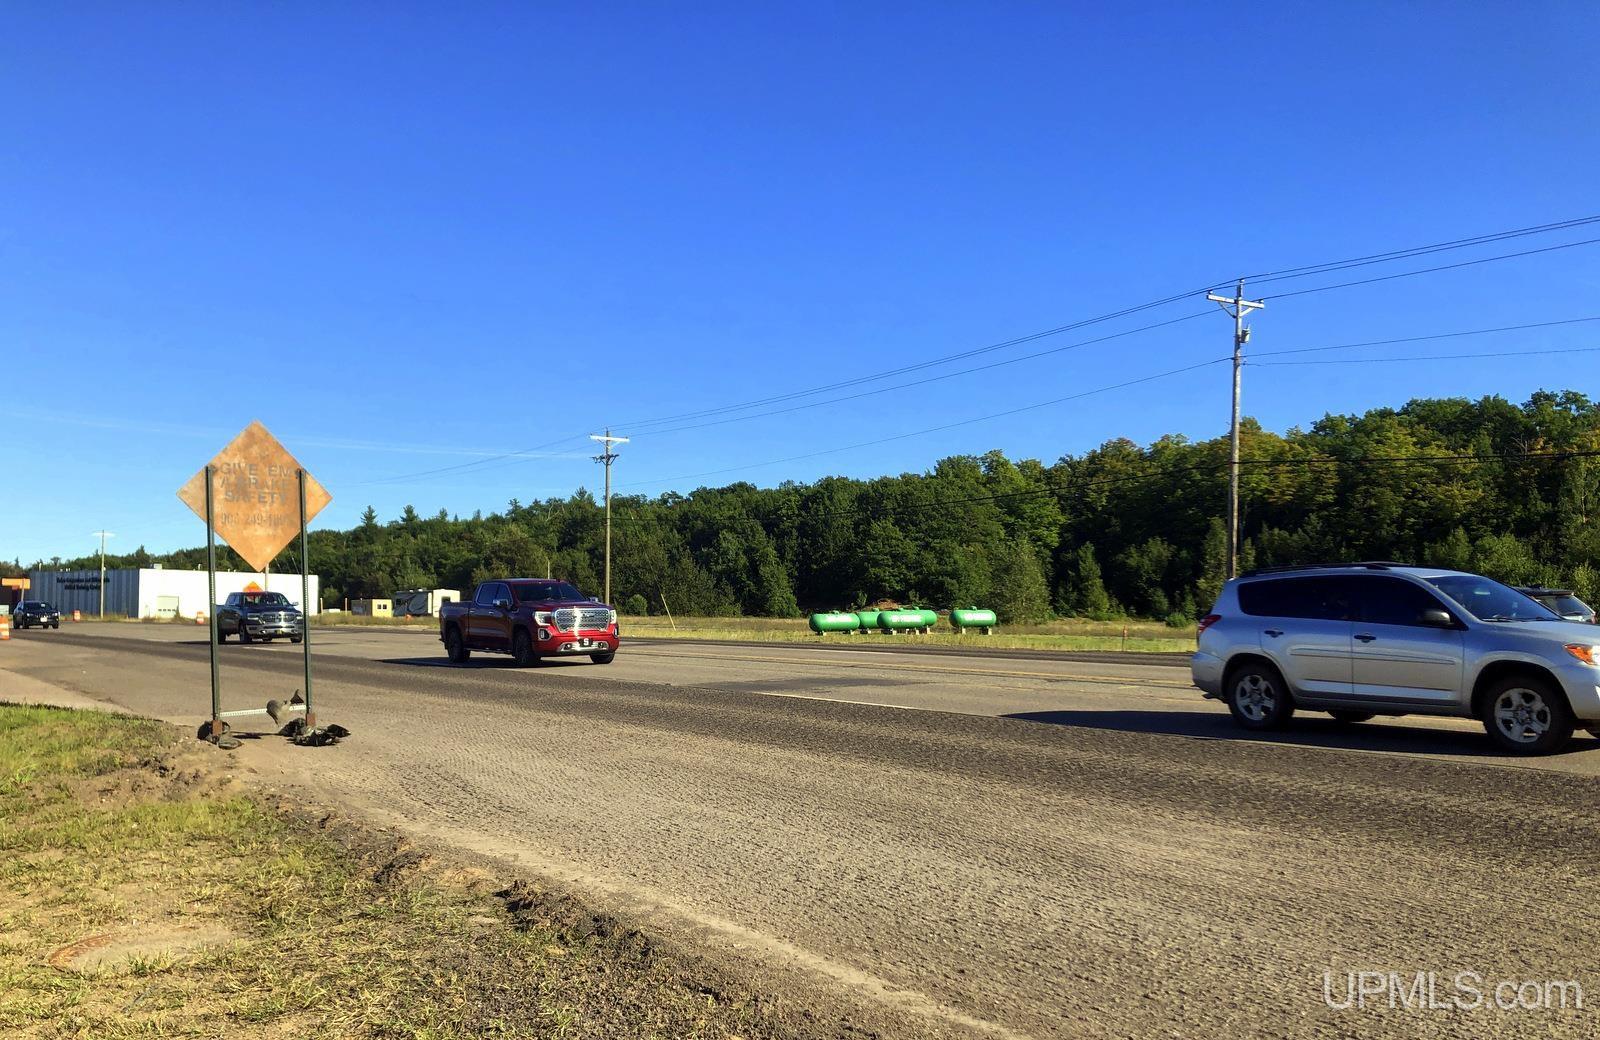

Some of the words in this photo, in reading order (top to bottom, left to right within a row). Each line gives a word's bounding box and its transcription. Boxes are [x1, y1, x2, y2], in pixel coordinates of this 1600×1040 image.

[220, 462, 258, 475] GIVE
[236, 476, 289, 489] RAKE
[224, 490, 288, 504] SAFETY
